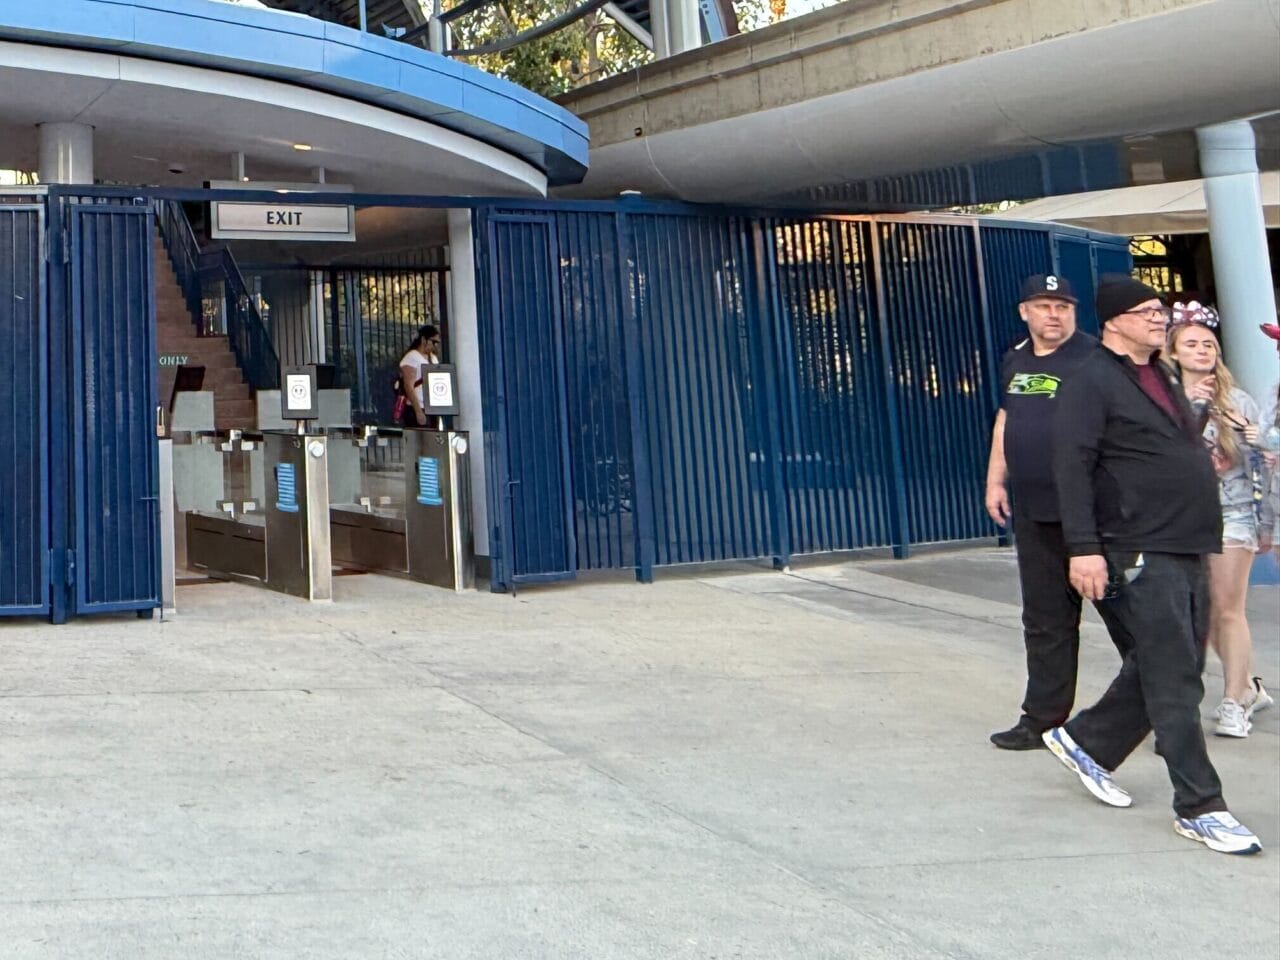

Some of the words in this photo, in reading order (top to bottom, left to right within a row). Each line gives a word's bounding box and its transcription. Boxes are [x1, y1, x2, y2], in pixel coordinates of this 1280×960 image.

[267, 211, 302, 225] EXIT
[1046, 275, 1059, 291] S
[159, 355, 188, 366] ONLY
